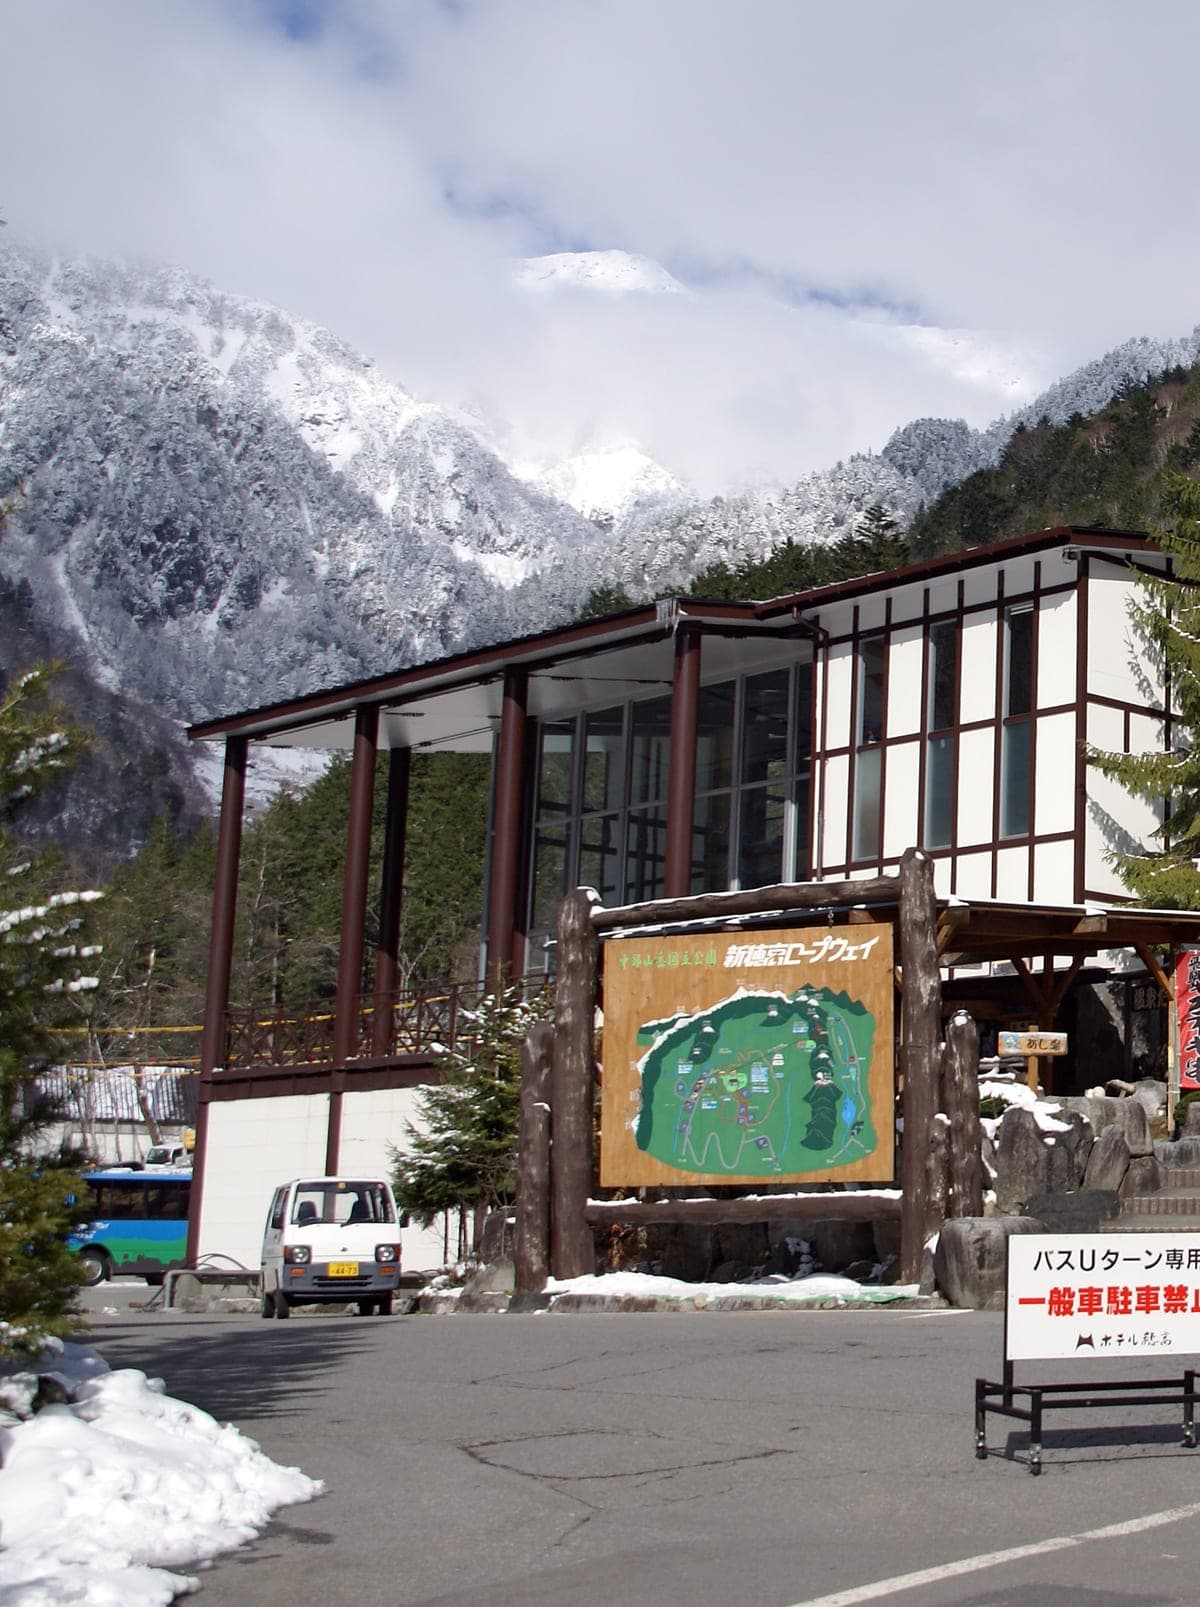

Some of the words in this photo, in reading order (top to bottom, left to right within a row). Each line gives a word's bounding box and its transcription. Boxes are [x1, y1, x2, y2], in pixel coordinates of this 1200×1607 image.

[723, 936, 880, 968] 新穂高ロープウェイ
